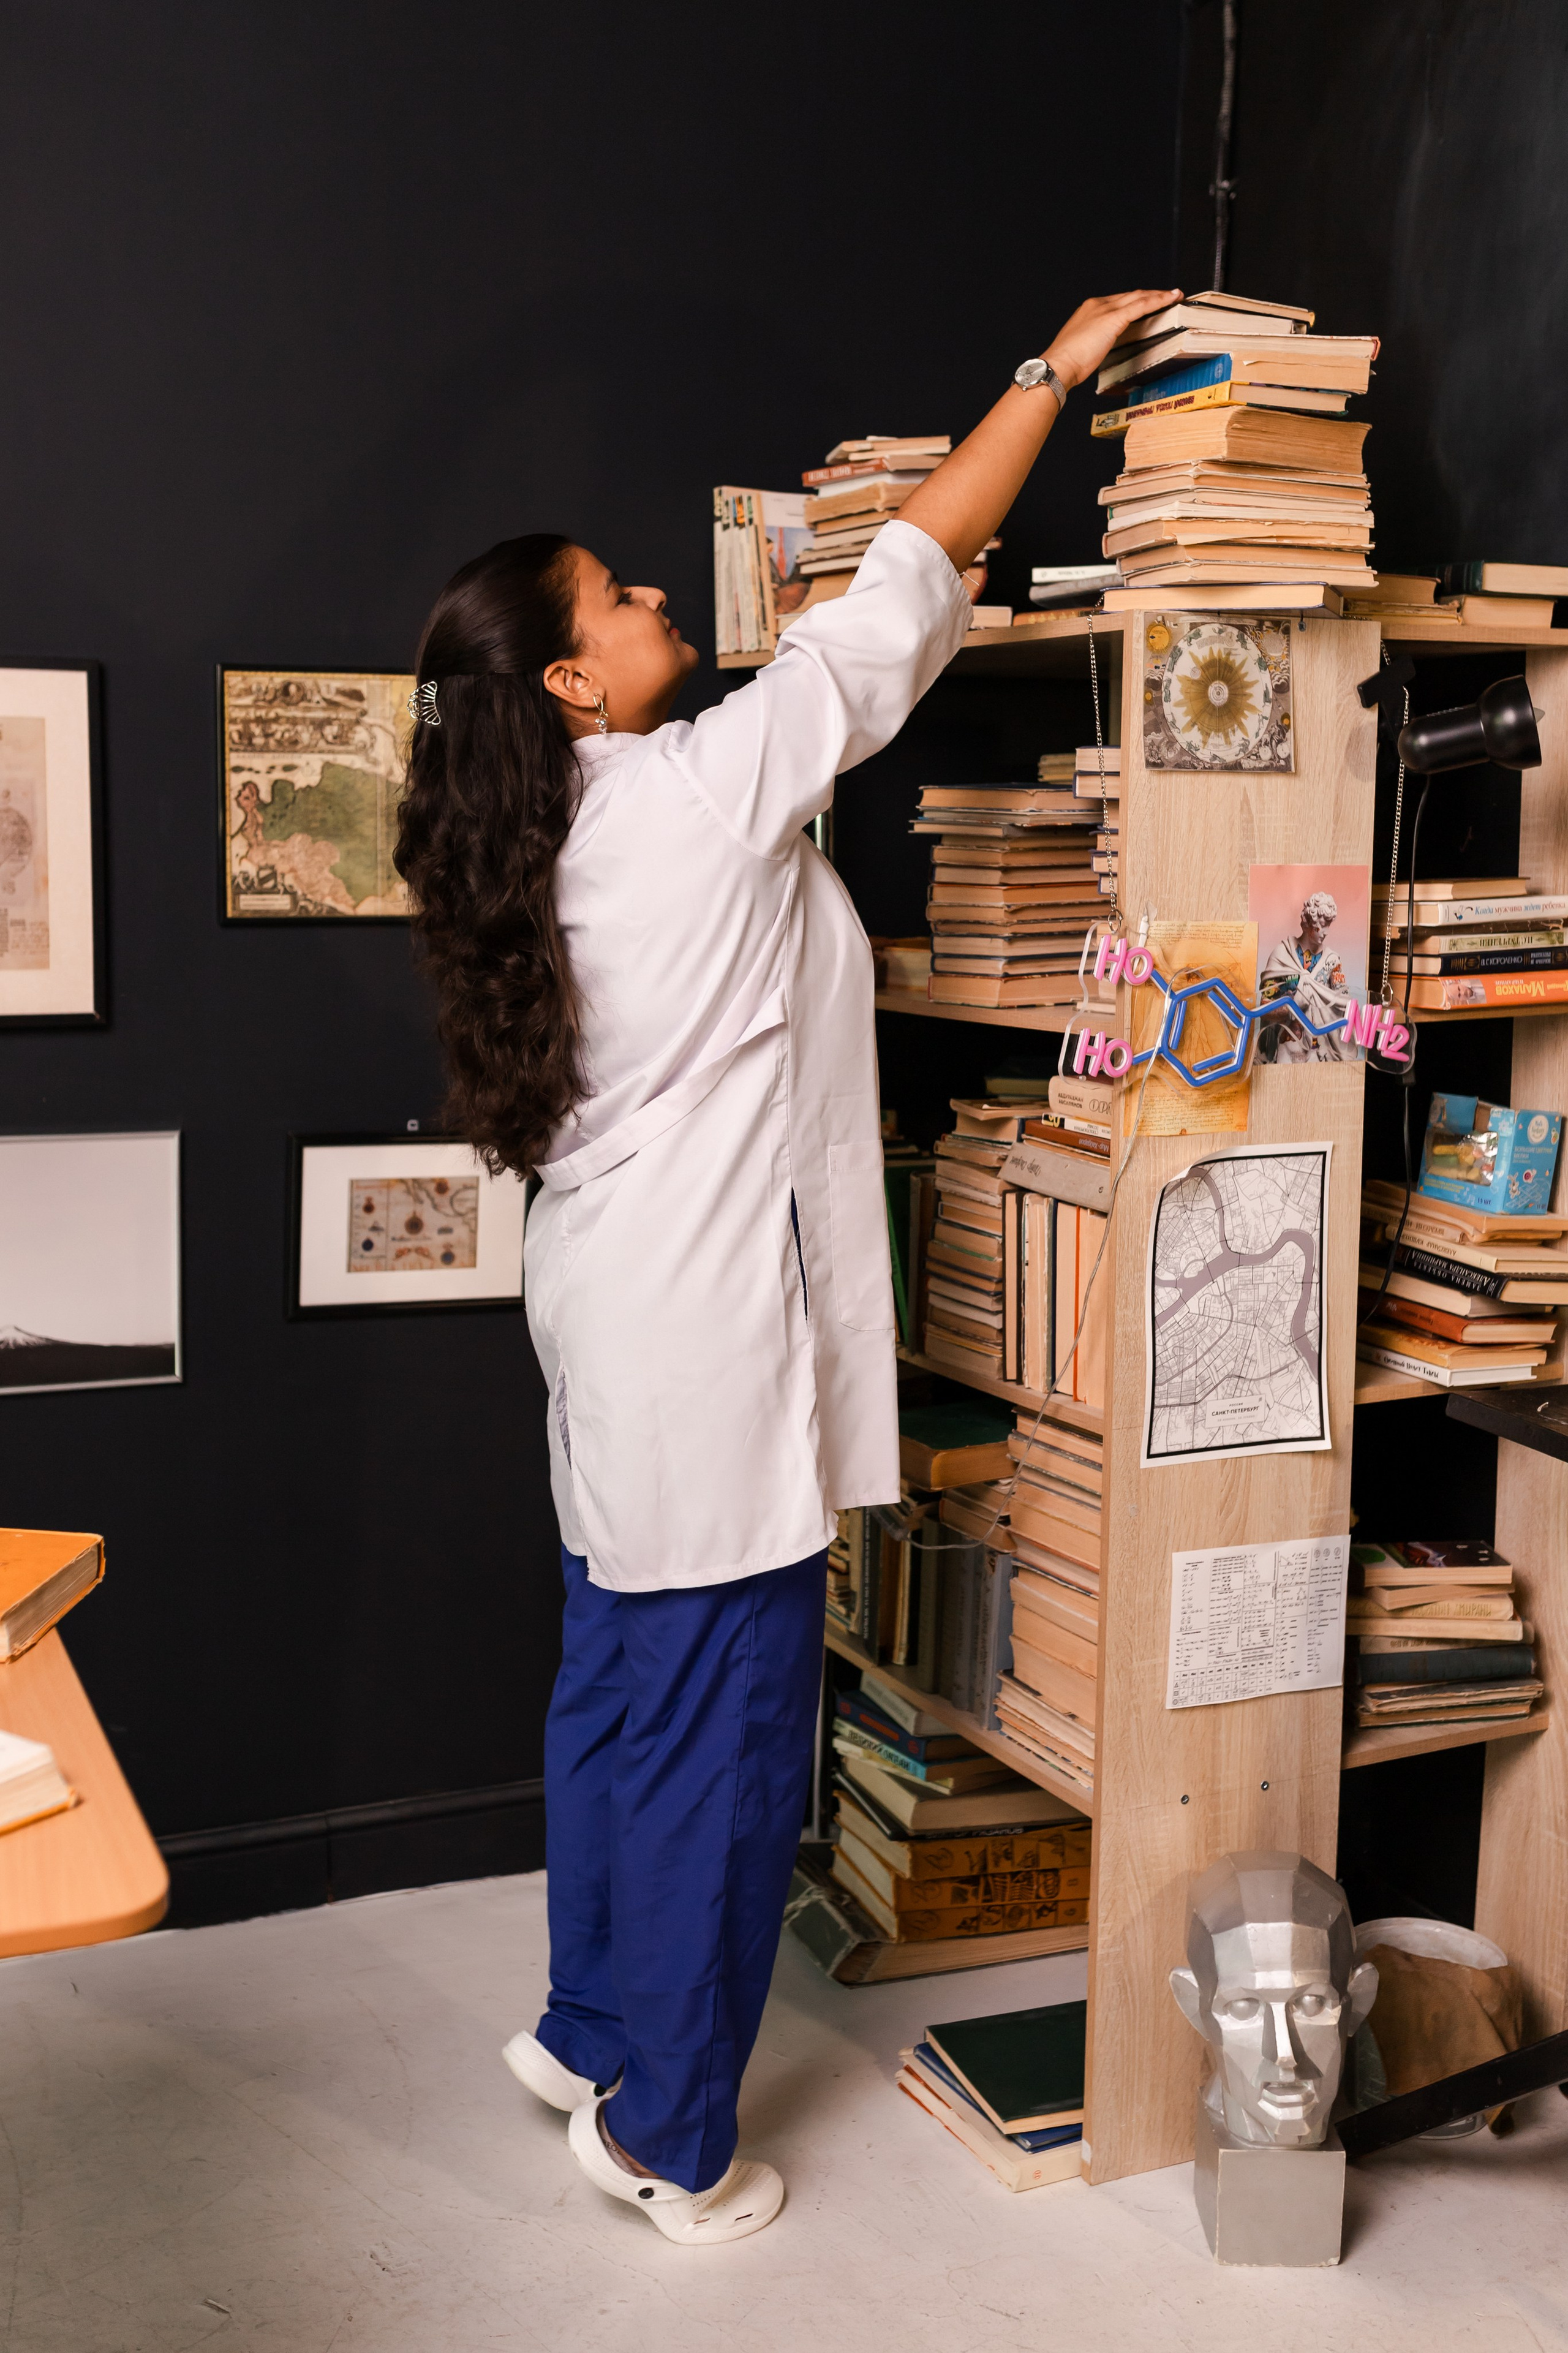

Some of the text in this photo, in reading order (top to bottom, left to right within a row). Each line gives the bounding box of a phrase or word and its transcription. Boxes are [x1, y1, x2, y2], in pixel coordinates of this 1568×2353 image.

[1475, 901, 1566, 916] Когда мужчина ждет ребенка
[1093, 935, 1153, 986] HO
[1340, 999, 1410, 1062] NH2
[1073, 1028, 1134, 1078] HO
[1425, 1241, 1457, 1256] АЛЕКСАНДР
[1411, 1249, 1491, 1288] АЛЕКСАНДРА МАРИНИНА
[1413, 1261, 1481, 1292] ЗАМЕНА ОБЪЕКТА
